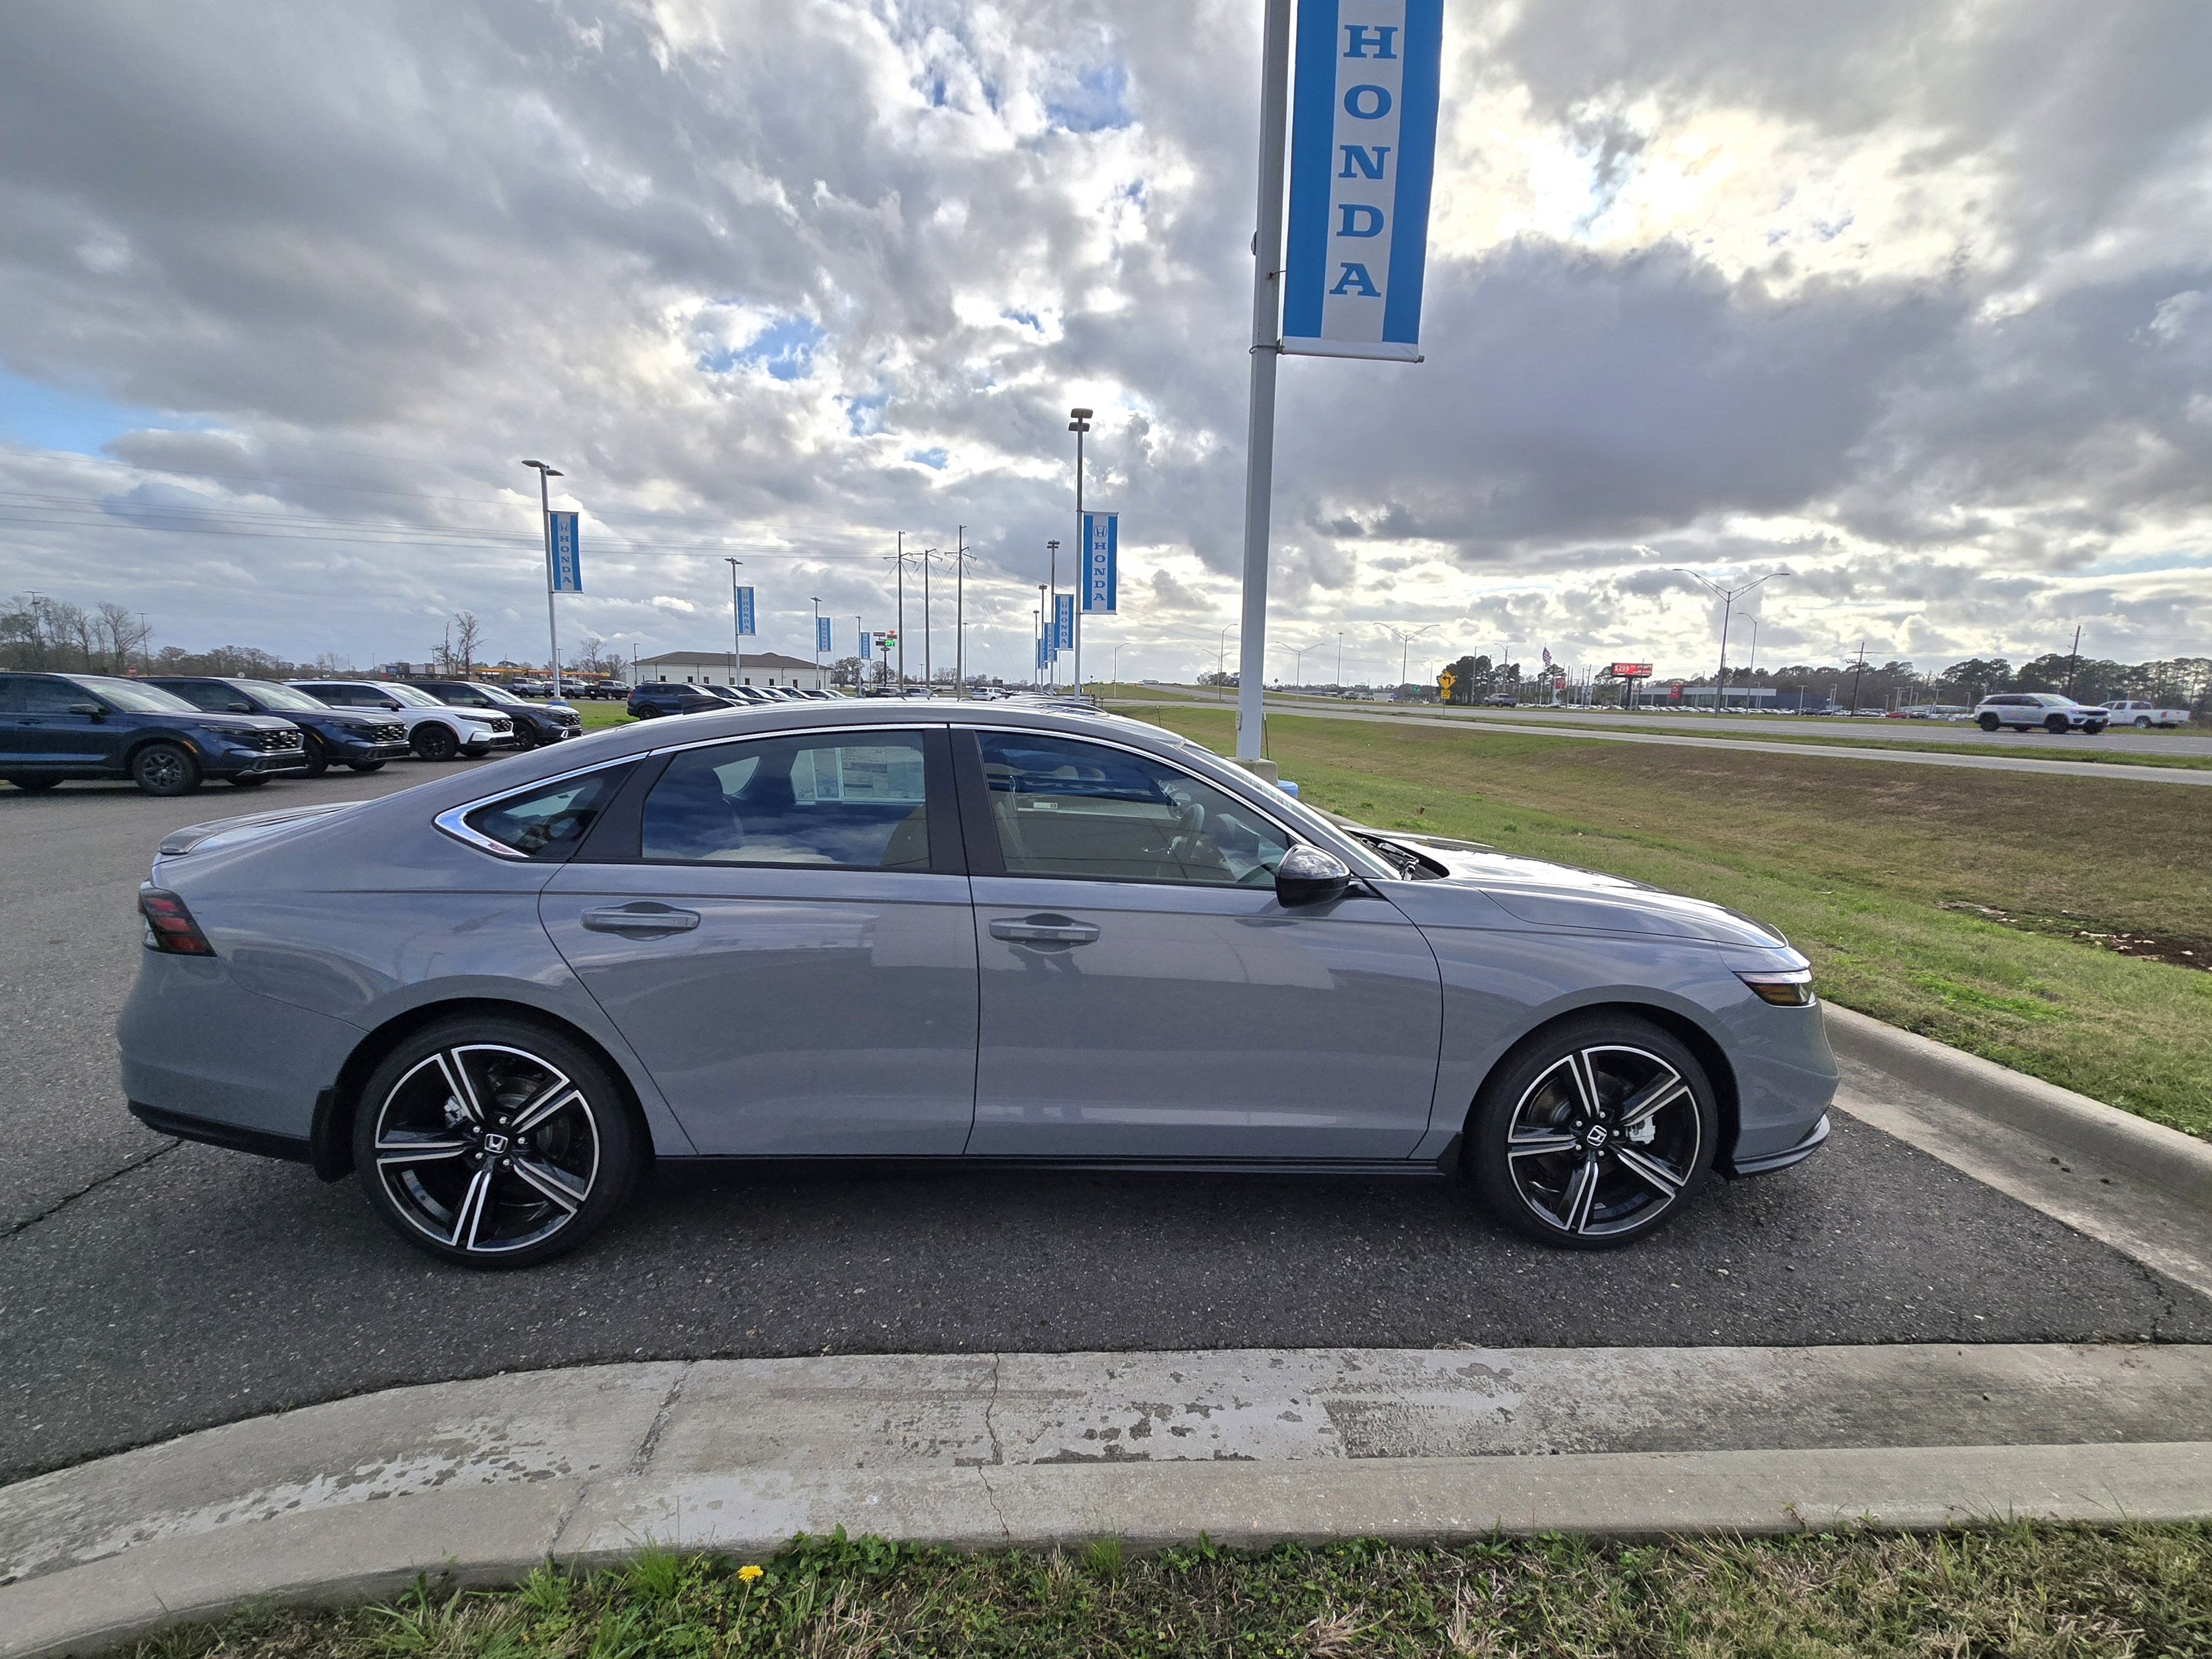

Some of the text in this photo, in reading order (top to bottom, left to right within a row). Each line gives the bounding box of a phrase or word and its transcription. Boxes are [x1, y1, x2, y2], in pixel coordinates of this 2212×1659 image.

[1329, 24, 1399, 297] HONDA
[560, 536, 572, 583] HONDA
[1093, 542, 1106, 601] HONDA
